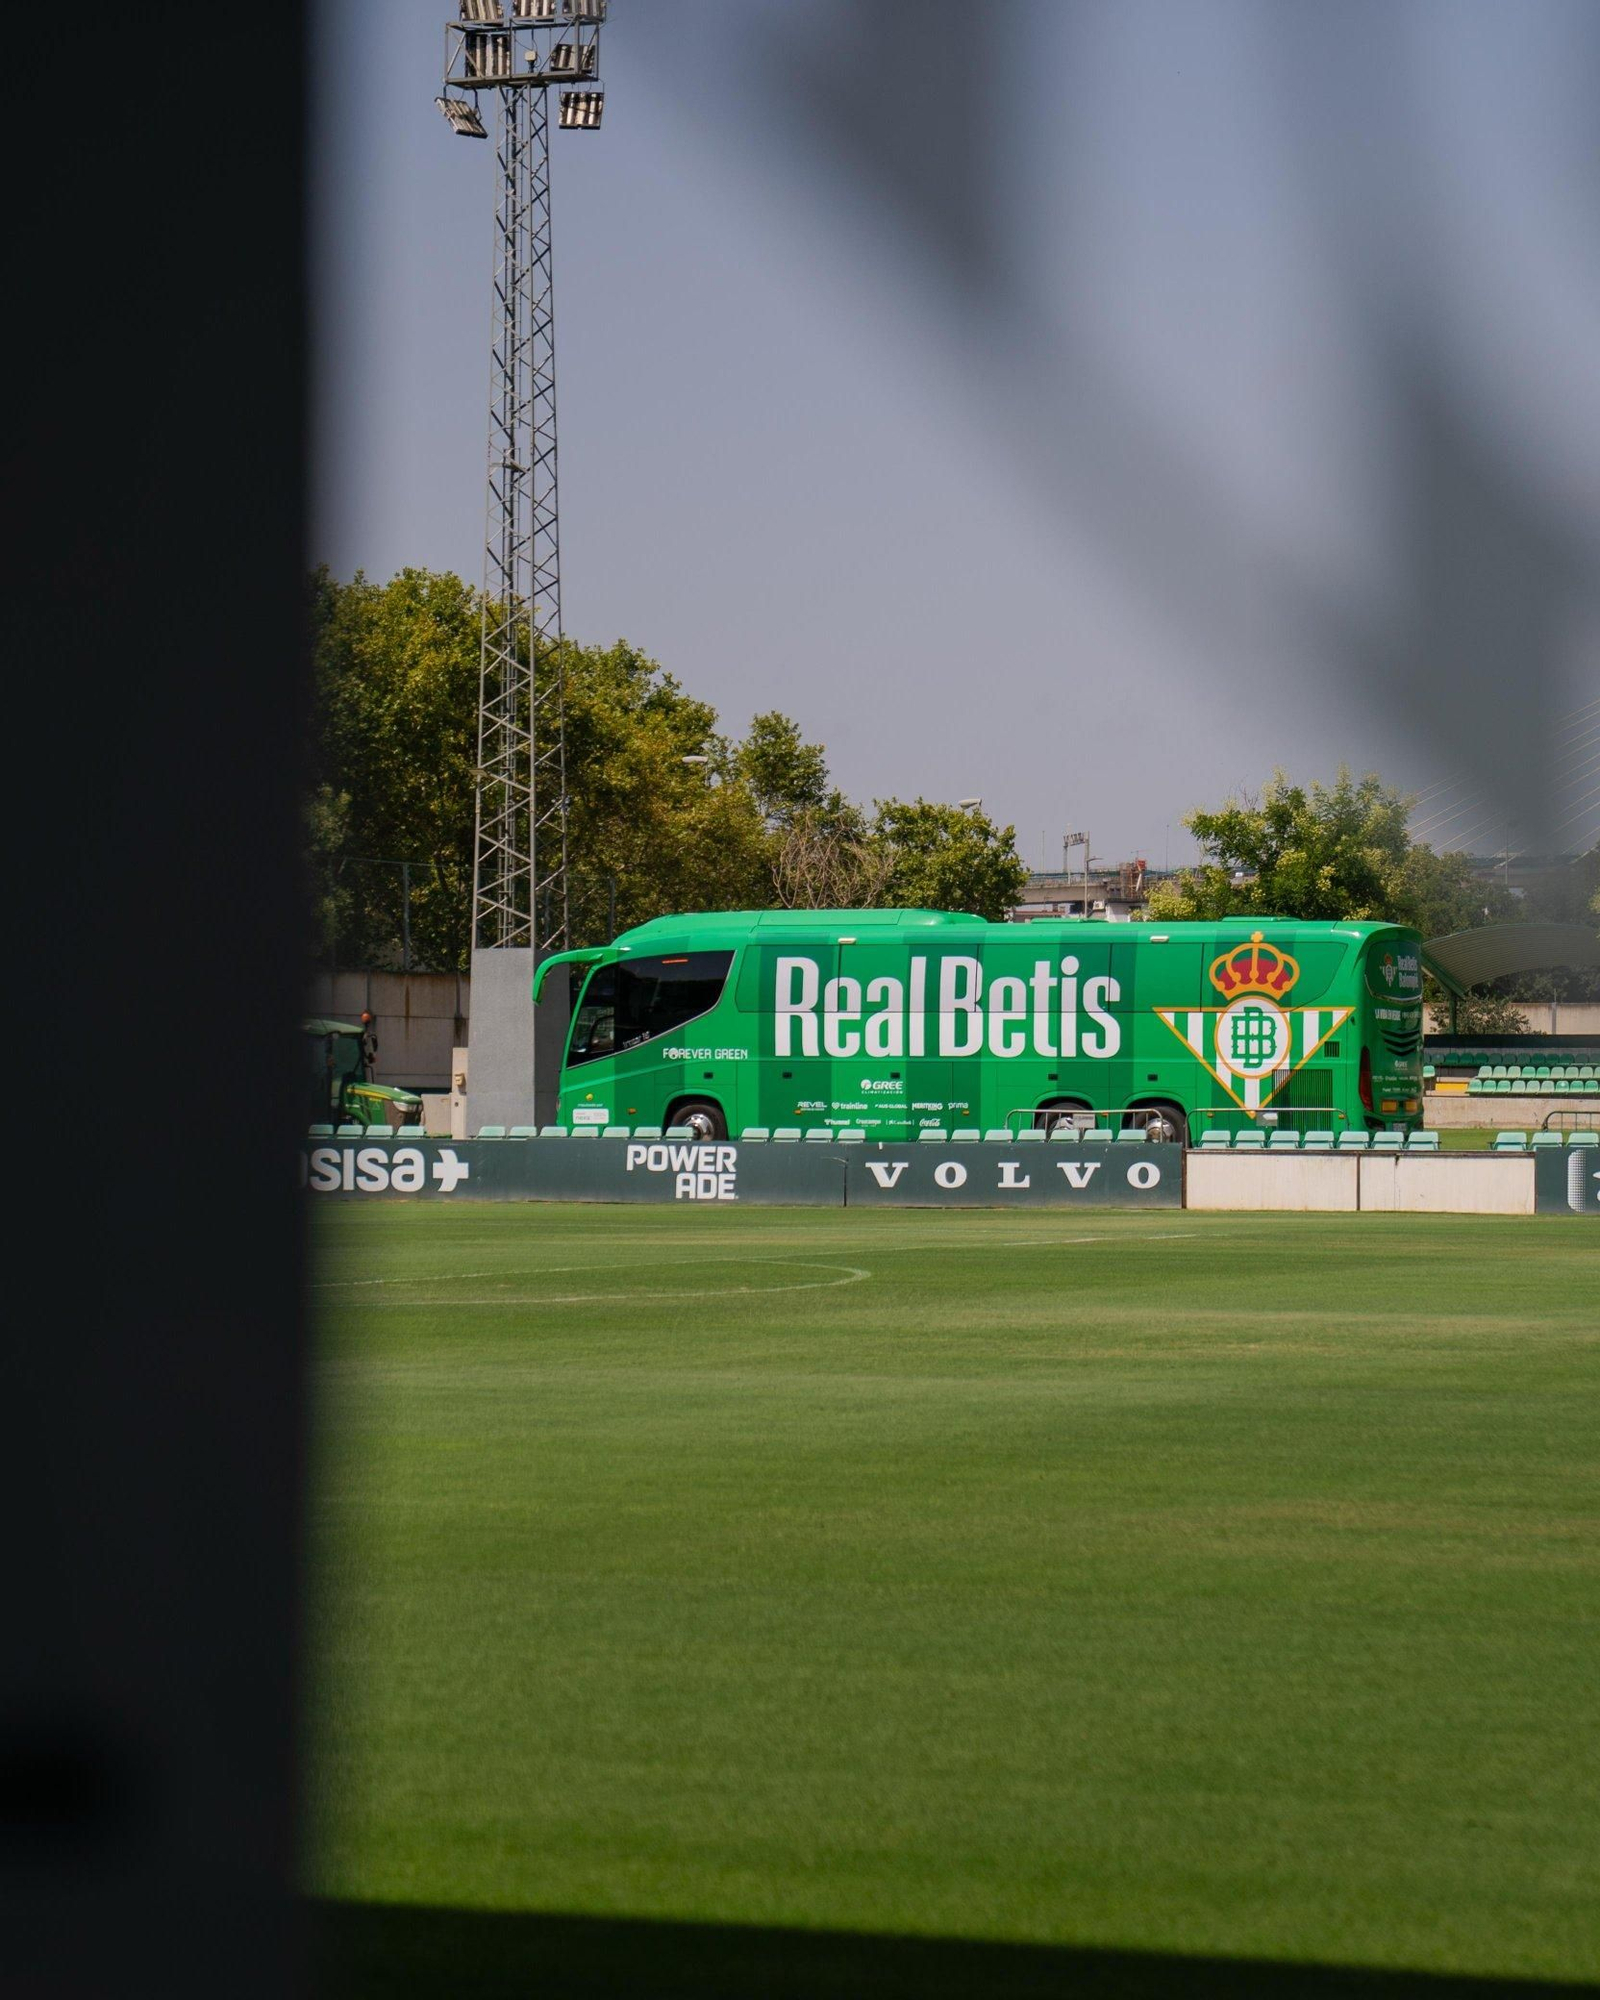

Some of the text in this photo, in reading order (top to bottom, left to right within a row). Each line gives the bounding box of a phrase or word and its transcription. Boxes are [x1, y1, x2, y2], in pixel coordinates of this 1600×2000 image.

[774, 955, 1121, 1059] Real Betis
[663, 1047, 748, 1060] FOREVER GREEN
[872, 1081, 903, 1090] GREE
[840, 1102, 868, 1110] trainline
[626, 1144, 738, 1173] POWER
[675, 1172, 736, 1200] ADE
[865, 1161, 1161, 1189] VOLVO
